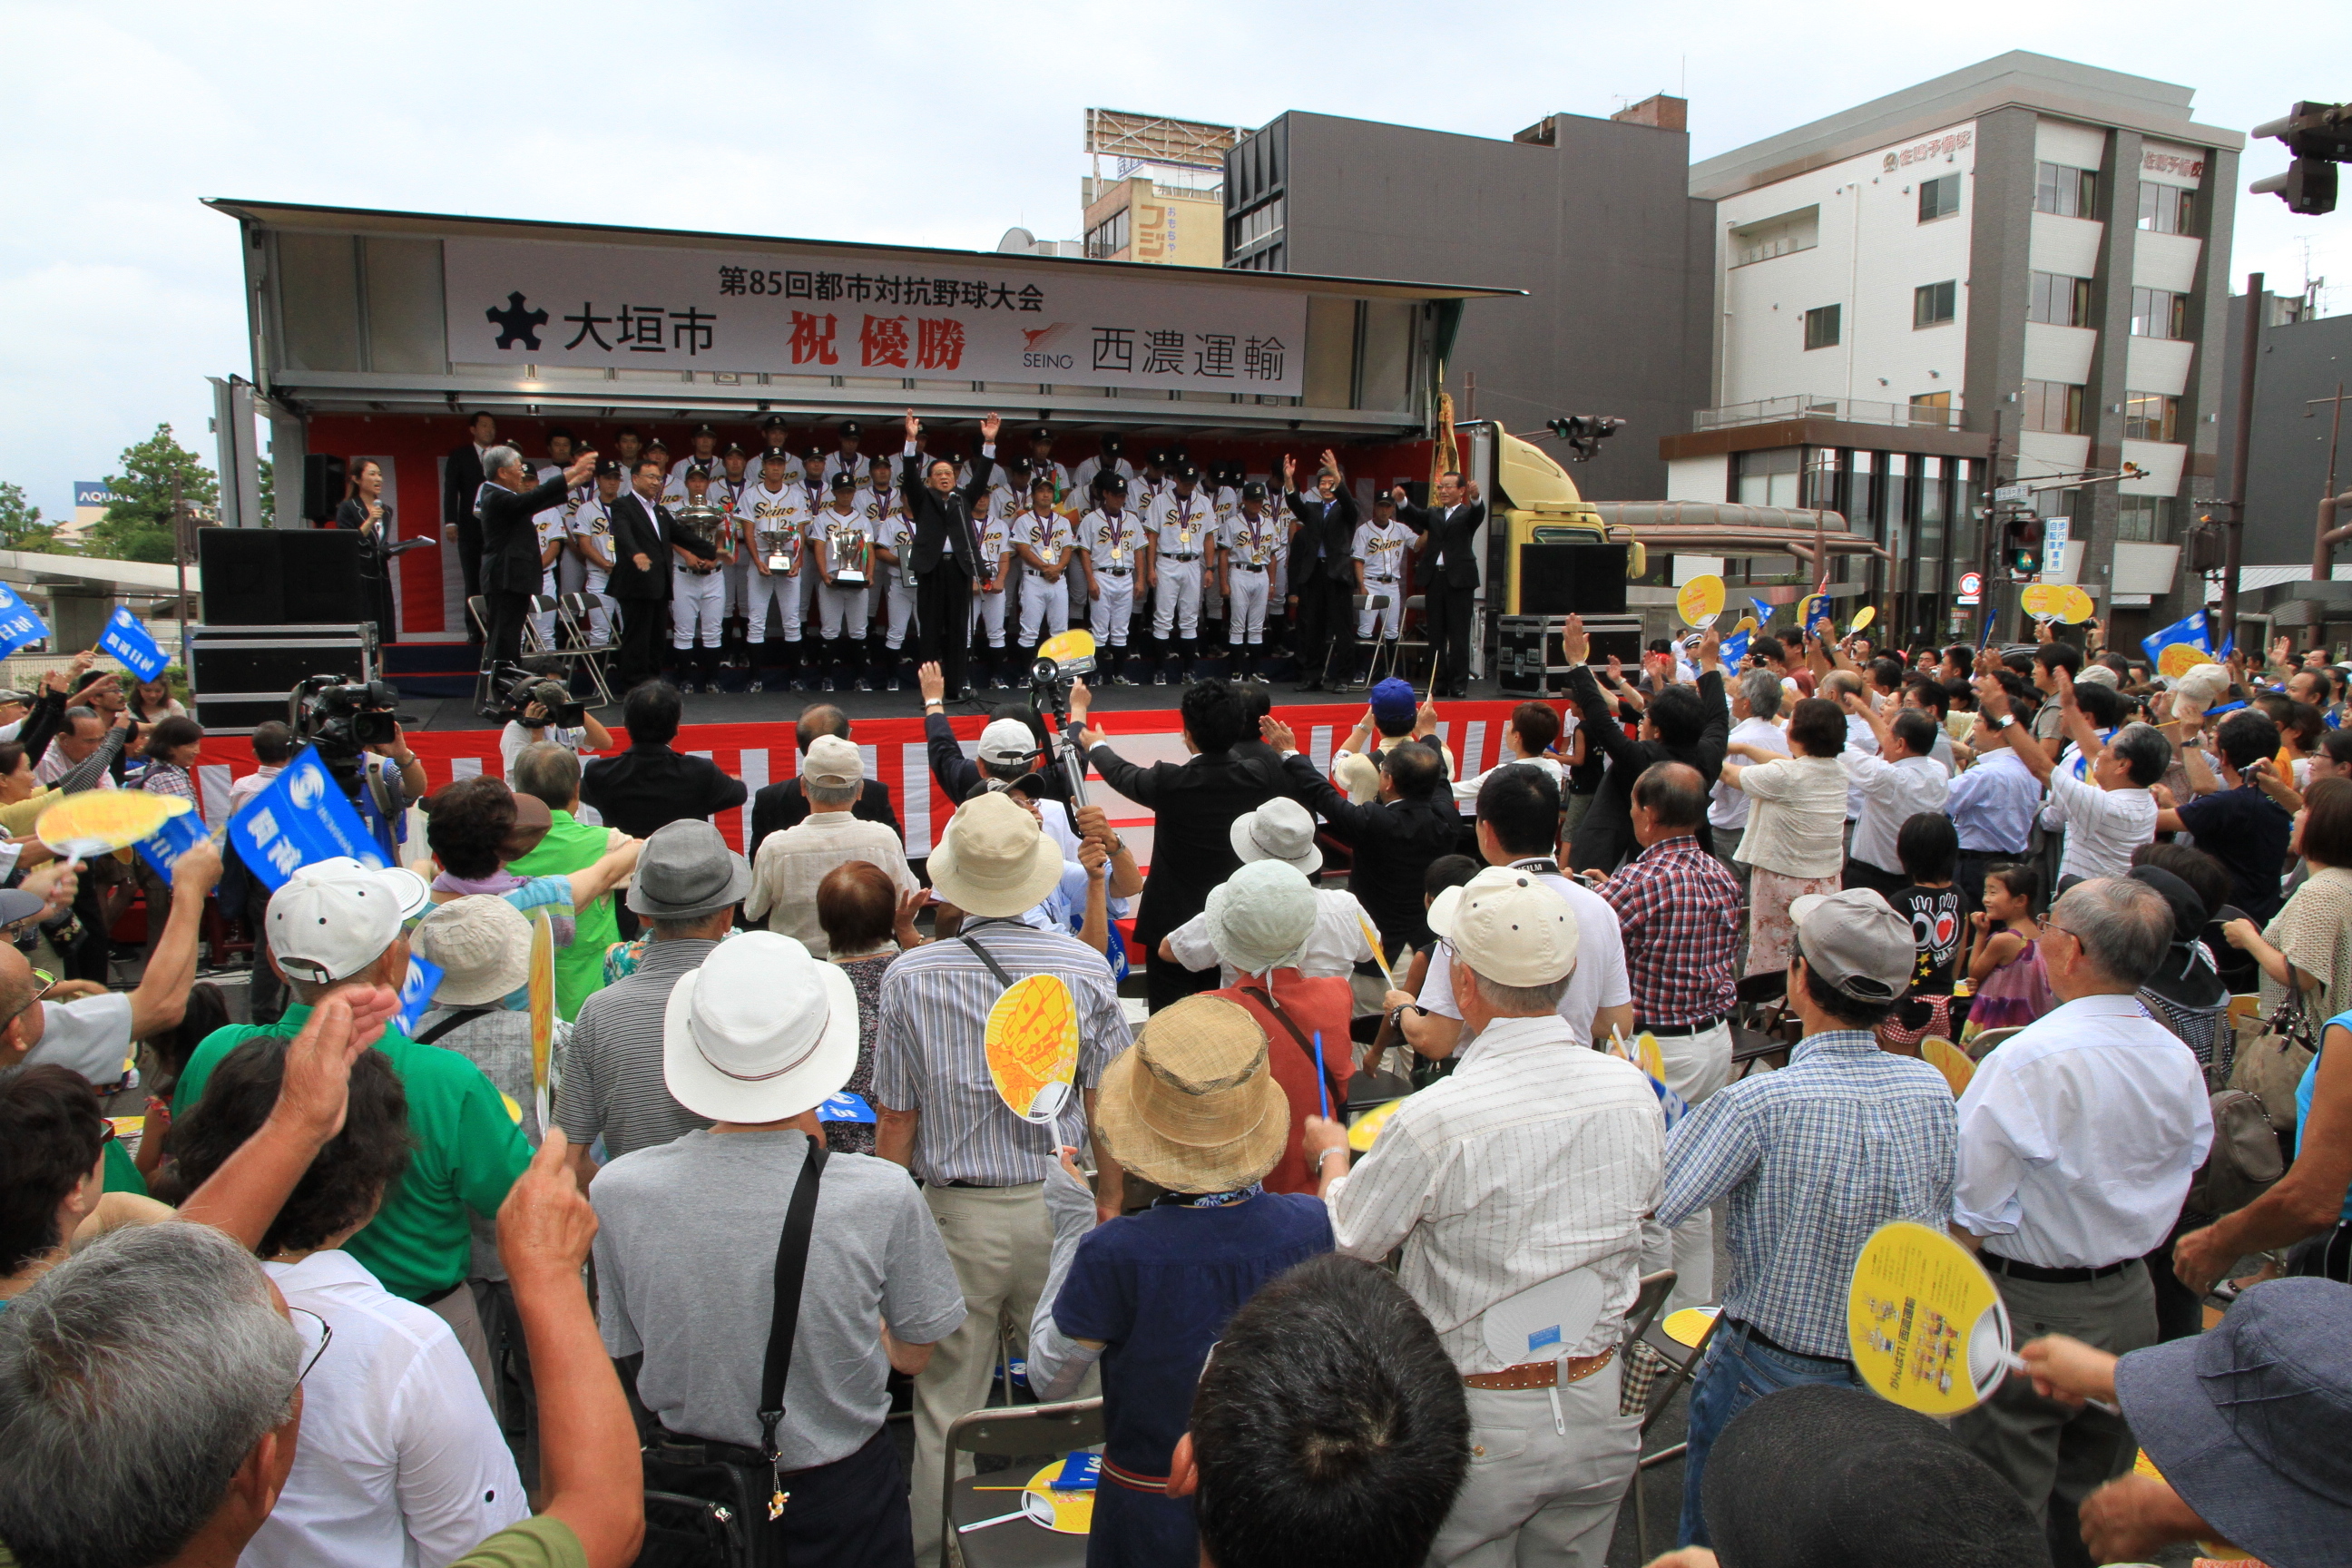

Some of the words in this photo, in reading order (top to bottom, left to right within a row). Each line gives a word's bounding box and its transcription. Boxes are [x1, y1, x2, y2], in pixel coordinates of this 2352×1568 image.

[1139, 204, 1165, 263] フジ
[719, 266, 1044, 312] 第85回都市対抗野球大会
[564, 301, 717, 356] 大垣市
[1023, 353, 1073, 369] SEINO
[1092, 327, 1286, 381] 西濃運輸
[754, 502, 795, 519] Seino
[1367, 537, 1403, 554] Seino
